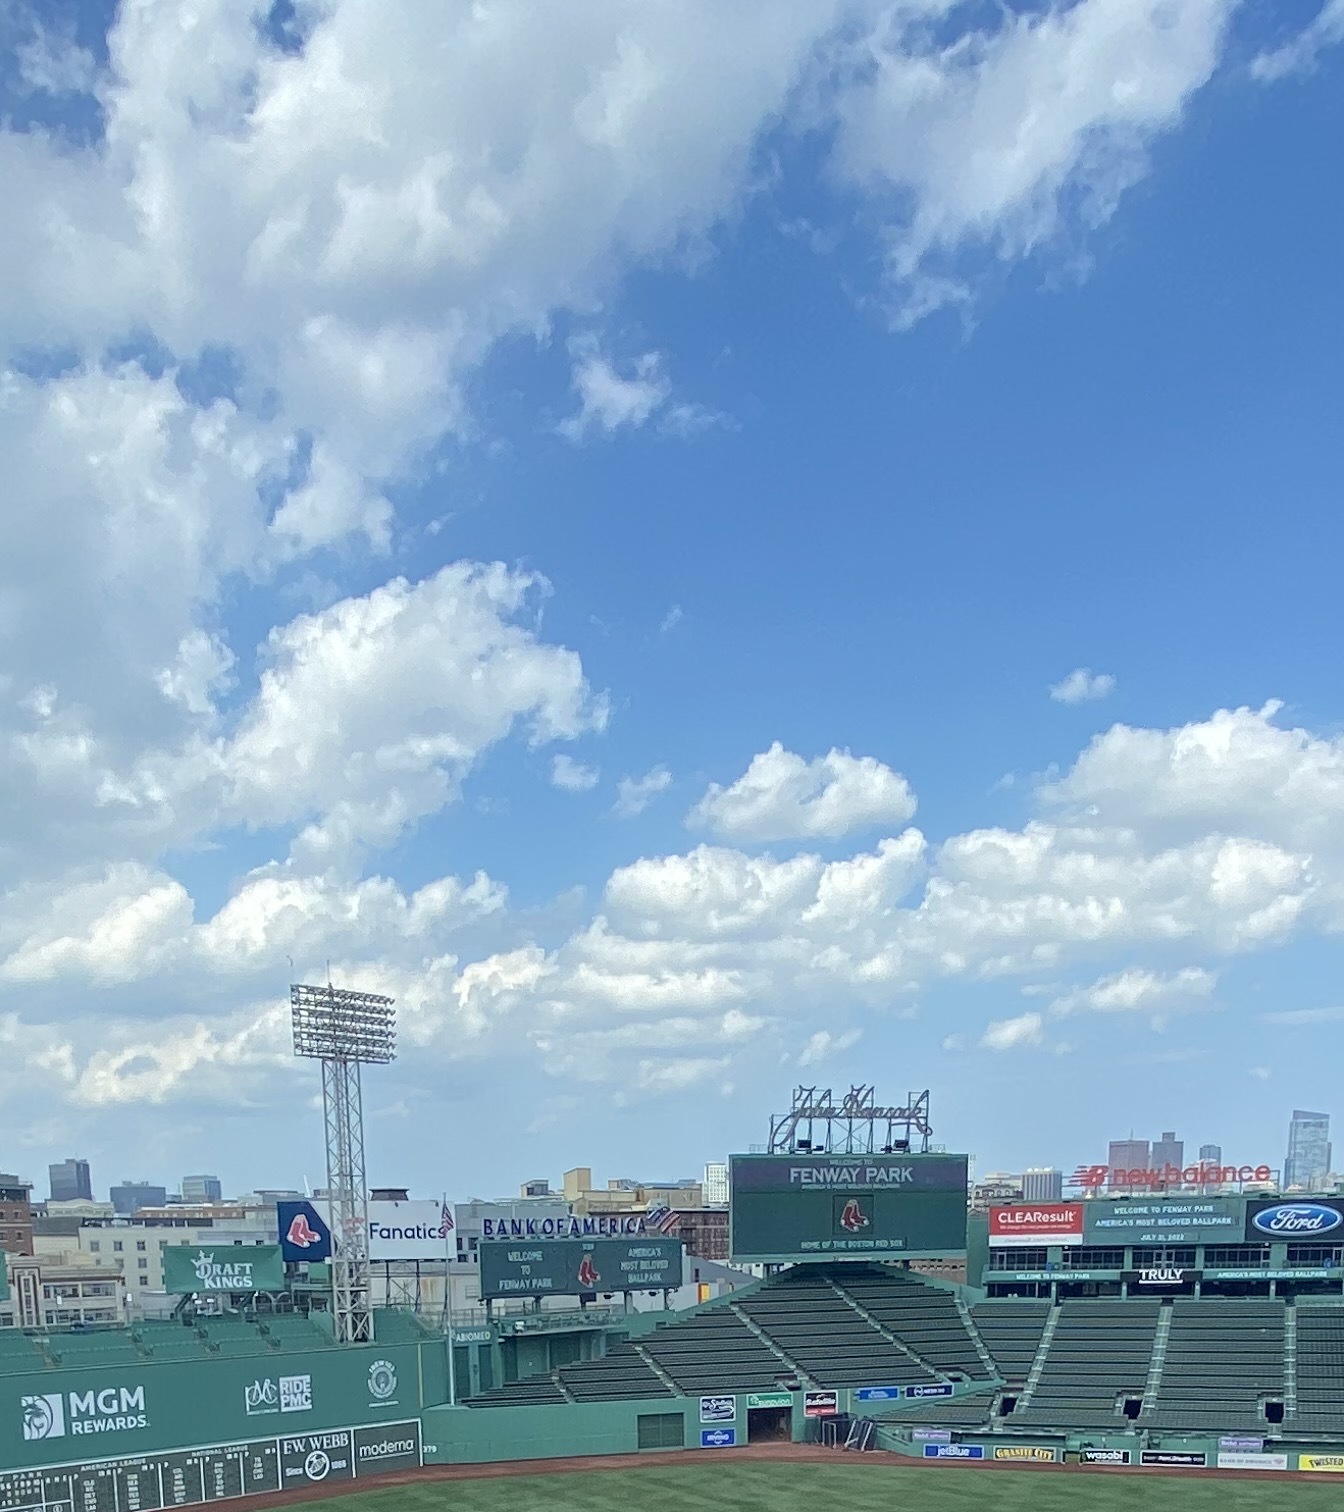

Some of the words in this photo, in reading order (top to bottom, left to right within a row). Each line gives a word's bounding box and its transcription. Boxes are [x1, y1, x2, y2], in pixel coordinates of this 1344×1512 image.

[790, 1167, 860, 1182] FENWAY
[865, 1166, 913, 1182] PARK
[1114, 1168, 1160, 1184] new
[1164, 1162, 1271, 1185] balance
[1114, 1206, 1148, 1214] WELCOME
[1151, 1205, 1160, 1213] TO
[1162, 1205, 1192, 1213] FENWAY
[1194, 1204, 1213, 1212] PARK
[998, 1210, 1077, 1223] CLEAResult
[1096, 1219, 1133, 1227] AMERICA'S
[1193, 1217, 1232, 1225] BALLPARK
[1270, 1209, 1324, 1229] Ford
[369, 1222, 447, 1239] Fanatics
[483, 1218, 536, 1236] BANK
[542, 1218, 565, 1235] OF
[568, 1216, 646, 1235] AMERICA
[508, 1251, 543, 1261] WELCOME
[196, 1263, 253, 1280] DRAFT
[620, 1260, 639, 1270] MOST
[628, 1273, 662, 1283] BALLPARK
[1138, 1269, 1183, 1280] TRULY
[204, 1276, 253, 1289] KINGS
[499, 1280, 530, 1290] FENWAY
[532, 1278, 552, 1288] PARK
[456, 1331, 491, 1342] ABIOMED
[281, 1380, 311, 1395] RIDE
[69, 1386, 145, 1418] MGM
[281, 1392, 312, 1408] PMC
[71, 1415, 147, 1435] REWARDS
[309, 1433, 349, 1450] WEBB
[359, 1439, 415, 1457] moderna
[937, 1445, 969, 1457] jetBlue
[996, 1449, 1033, 1458] GRANITE
[1035, 1447, 1054, 1460] CITY
[1086, 1450, 1123, 1460] wasabi
[81, 1462, 117, 1471] AMERICAN
[120, 1458, 146, 1467] LEAGUE
[1308, 1457, 1343, 1467] TWISTED
[13, 1471, 42, 1481] PARK
[286, 1467, 303, 1477] Since
